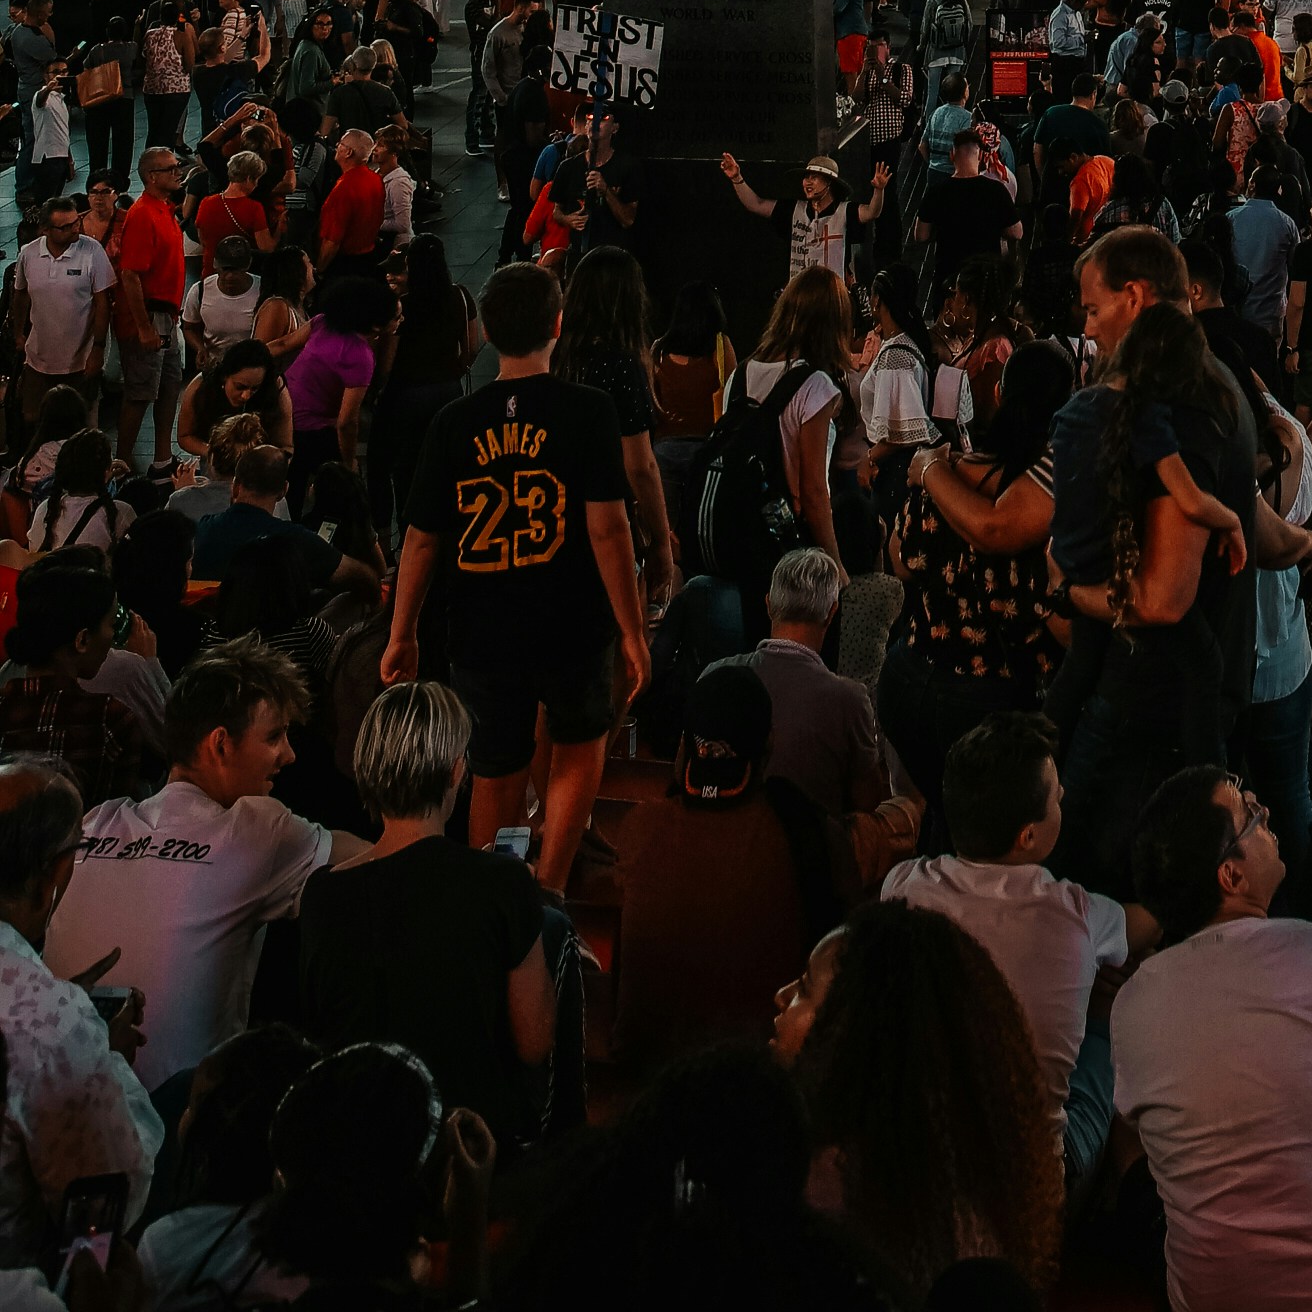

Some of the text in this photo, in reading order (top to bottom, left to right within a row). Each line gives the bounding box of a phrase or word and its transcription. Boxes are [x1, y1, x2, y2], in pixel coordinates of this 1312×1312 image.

[557, 4, 665, 50] TRUST
[723, 9, 754, 22] WAR
[580, 33, 620, 63] IN
[768, 51, 812, 64] CROSS
[551, 49, 658, 109] JESUS
[473, 421, 548, 467] JAMES
[455, 468, 567, 573] 23
[701, 785, 718, 799] USA
